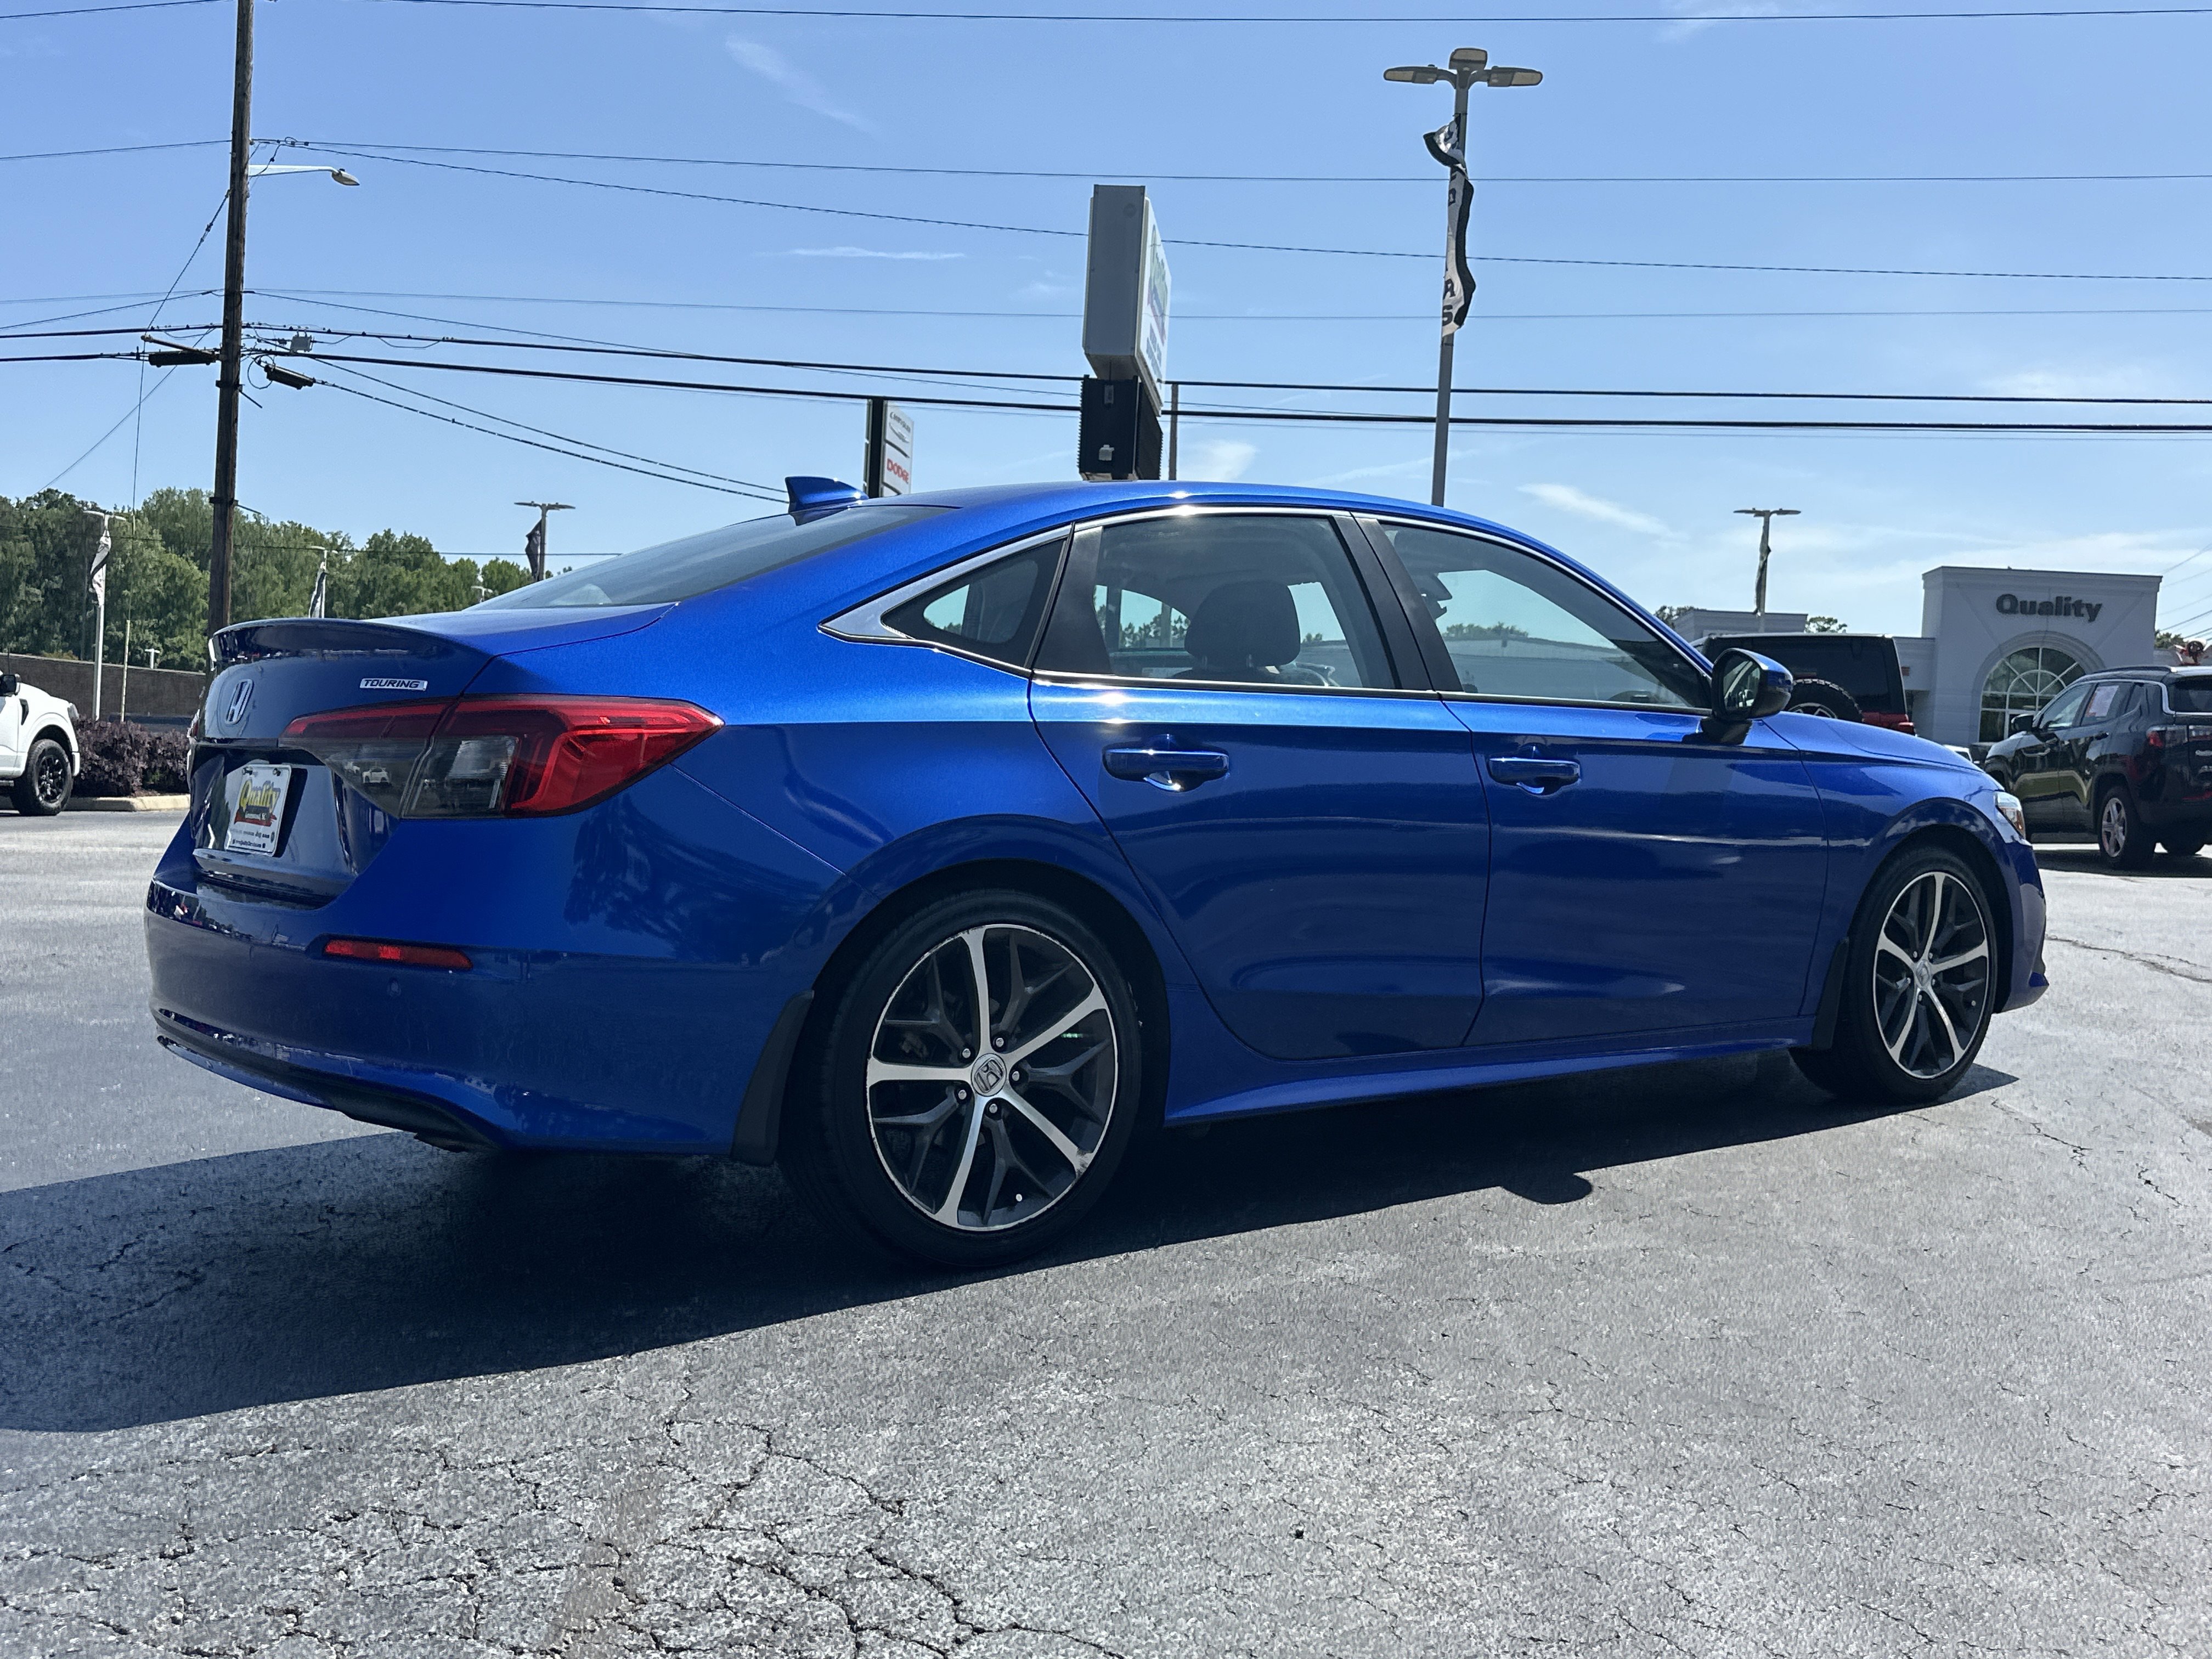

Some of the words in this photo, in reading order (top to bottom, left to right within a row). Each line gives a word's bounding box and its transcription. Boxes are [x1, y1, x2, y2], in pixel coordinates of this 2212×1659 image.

[1995, 593, 2103, 623] Quality
[364, 679, 421, 689] TOURING
[239, 779, 280, 813] Quality
